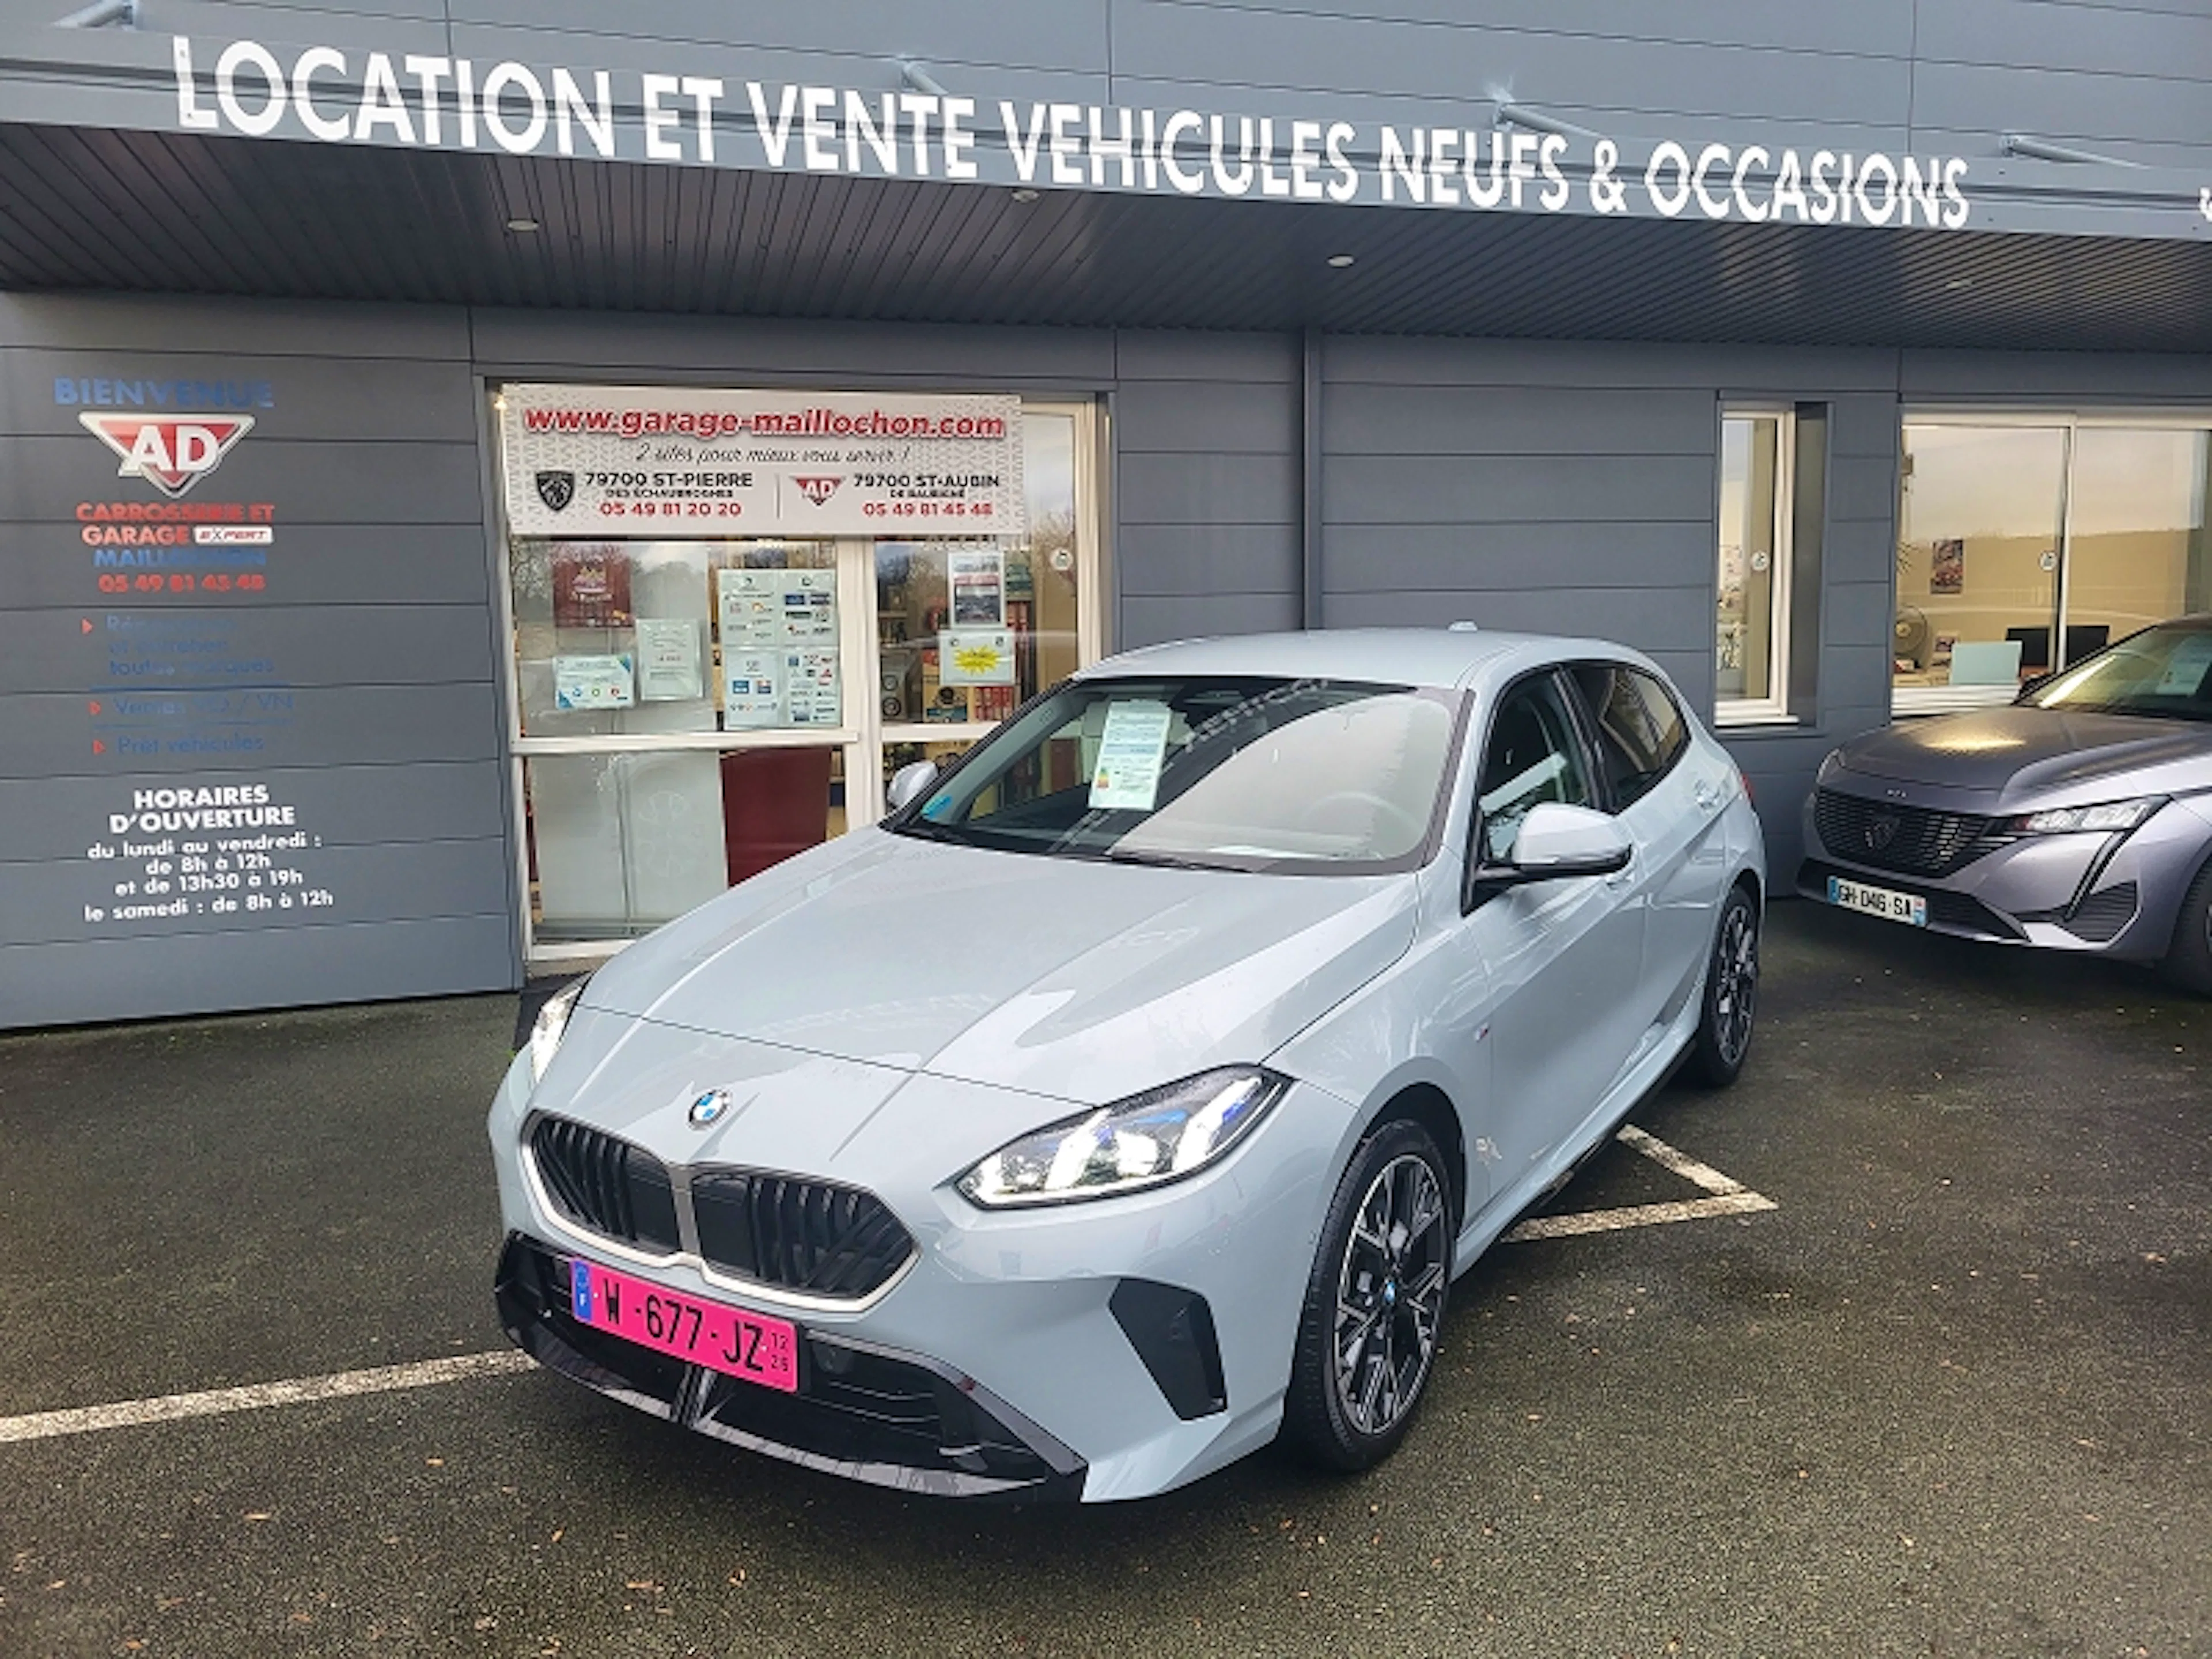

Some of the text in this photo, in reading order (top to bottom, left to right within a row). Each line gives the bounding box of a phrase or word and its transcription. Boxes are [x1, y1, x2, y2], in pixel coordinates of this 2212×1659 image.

[172, 35, 1970, 229] LOCATION ET VENTE VEHICULES NEUFS & OCCASIONS
[53, 377, 274, 408] BIENVENUE
[525, 407, 1005, 438] www.garage-maillochon.com
[118, 424, 221, 477] AD
[585, 472, 753, 487] 79700 ST-PIERRE
[853, 473, 999, 487] 79700 ST-AUBIN
[75, 502, 275, 522] CARROSSERIE ET
[600, 503, 625, 516] 05
[631, 502, 656, 515] 49
[688, 502, 711, 515] 20
[718, 502, 741, 515] 20
[863, 502, 888, 516] 05
[892, 502, 915, 516] 49
[920, 502, 938, 516] 81
[942, 502, 965, 516] 45
[81, 524, 189, 546] GARAGE
[134, 573, 164, 593] 49
[133, 784, 270, 809] HORAIRES
[109, 806, 296, 834] D'OUVERTURE
[87, 842, 115, 859] du
[123, 838, 174, 858] lundi
[181, 841, 209, 854] au
[217, 831, 308, 853] vendredi
[145, 852, 272, 876] de 8h à 12h
[115, 869, 304, 897] et de 13h30 à 19h
[84, 903, 105, 922] le
[112, 897, 188, 920] samedi
[211, 896, 238, 914] de
[245, 893, 272, 911] 8h
[278, 892, 293, 909] à
[300, 889, 334, 907] 12h
